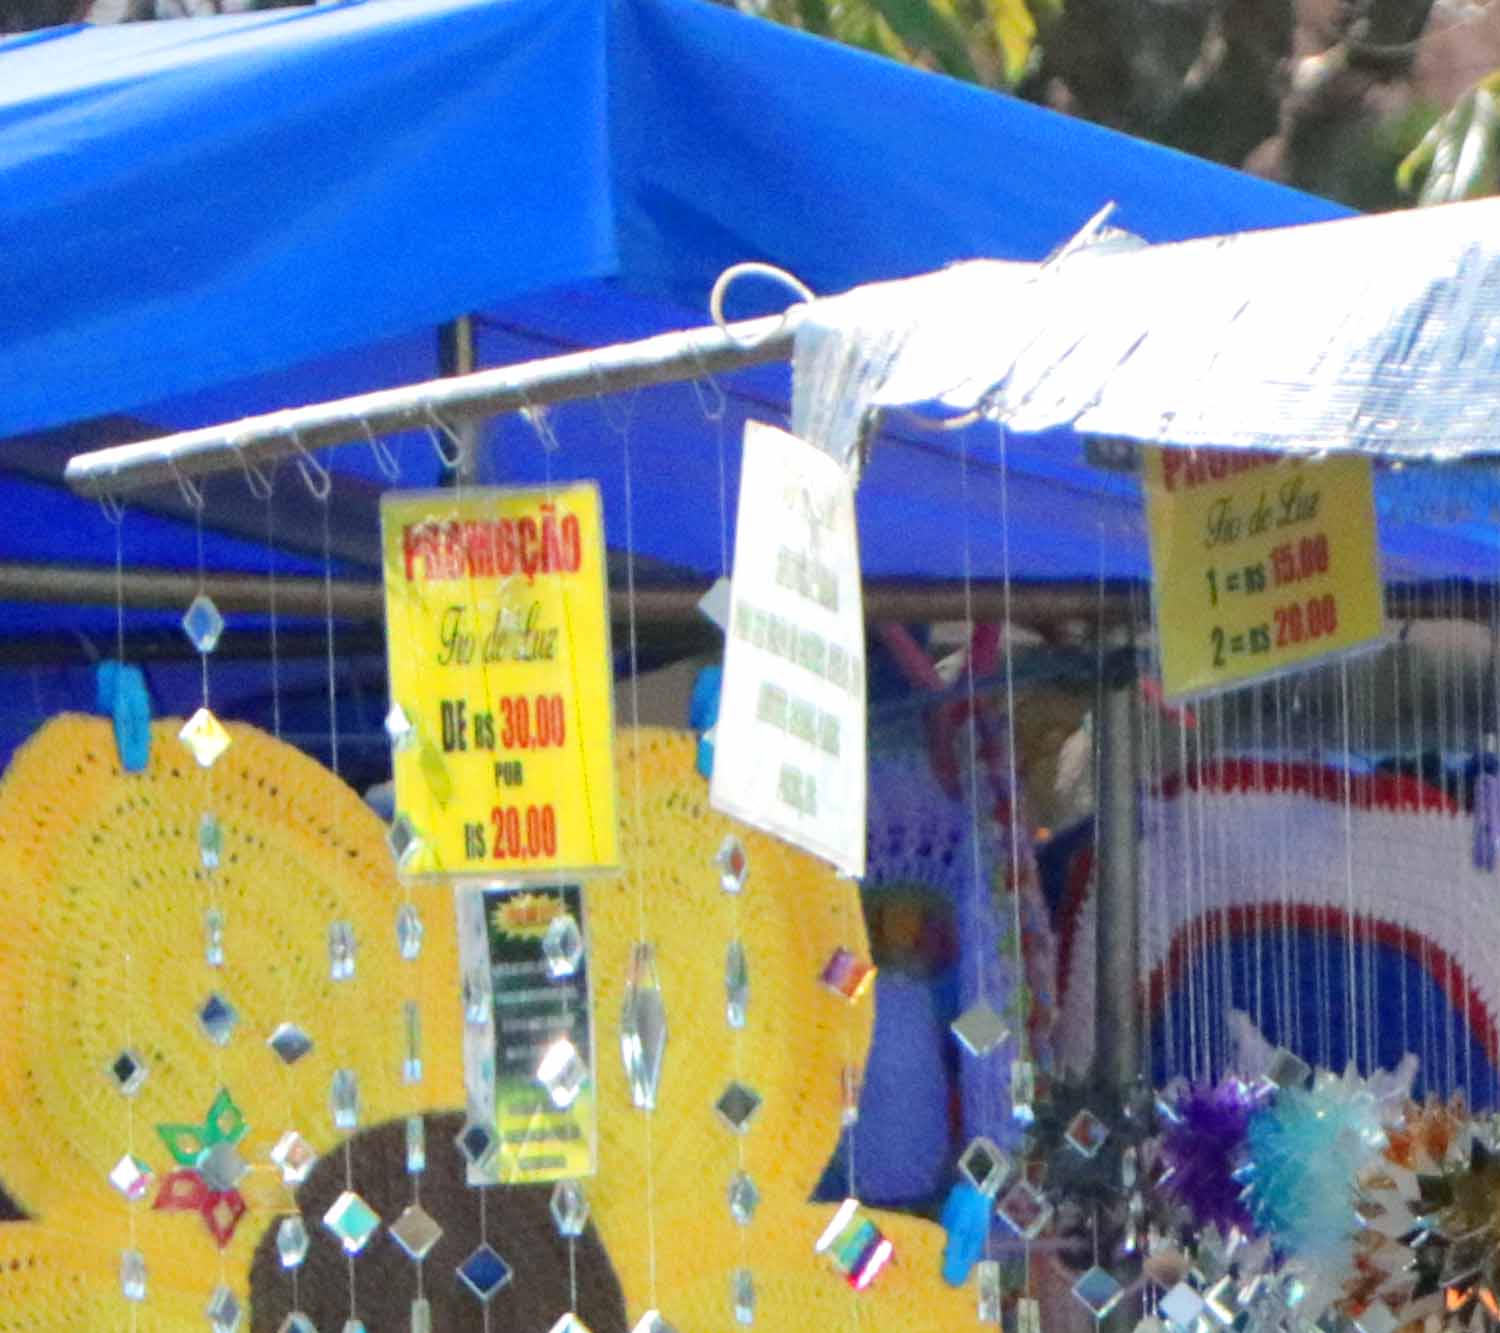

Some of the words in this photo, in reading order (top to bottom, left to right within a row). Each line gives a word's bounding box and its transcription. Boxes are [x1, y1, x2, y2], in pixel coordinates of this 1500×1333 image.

[404, 504, 581, 587] PROMOÇÃO
[1211, 626, 1225, 667] 2
[442, 700, 467, 752] DE
[474, 714, 494, 749] R$
[500, 694, 566, 751] 30,00
[494, 761, 523, 787] POR
[465, 824, 486, 860] R$
[491, 805, 557, 863] 20,00
